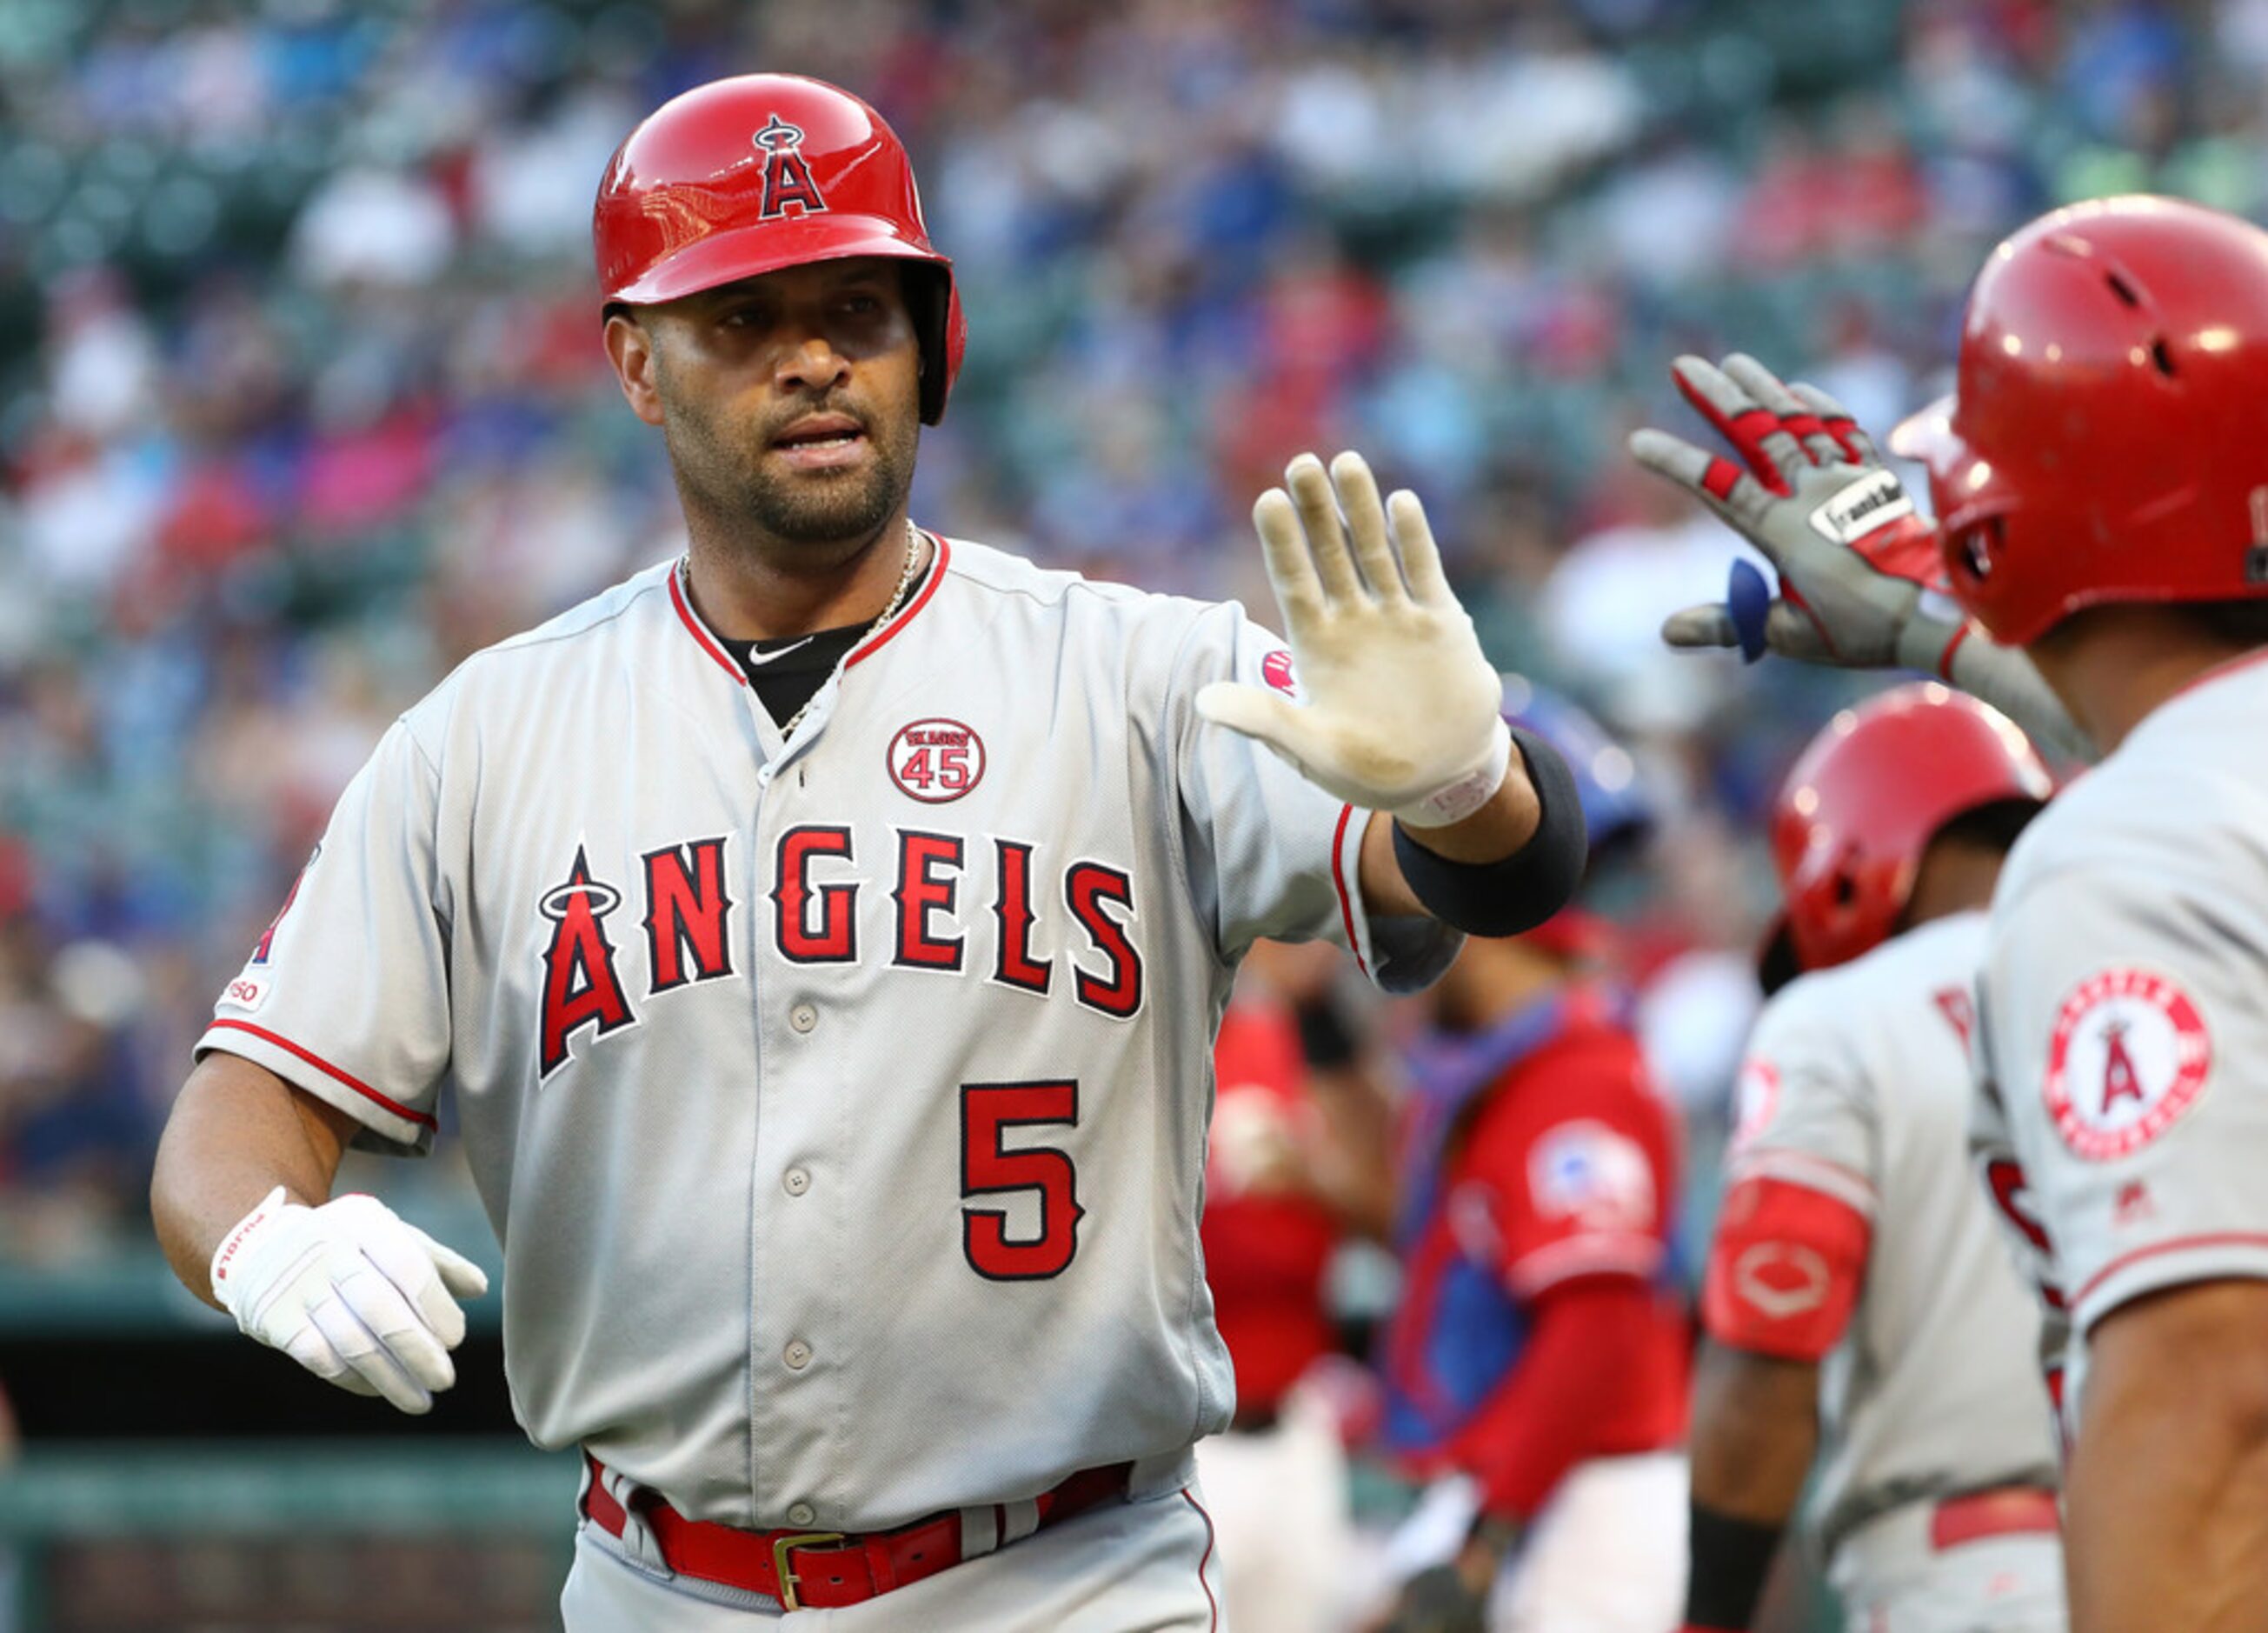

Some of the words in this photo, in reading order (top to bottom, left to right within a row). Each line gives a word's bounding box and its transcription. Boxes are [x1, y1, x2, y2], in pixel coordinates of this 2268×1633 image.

[754, 114, 828, 219] A
[901, 749, 969, 789] 45
[537, 823, 1145, 1087] ANGELS
[961, 1079, 1085, 1283] 5
